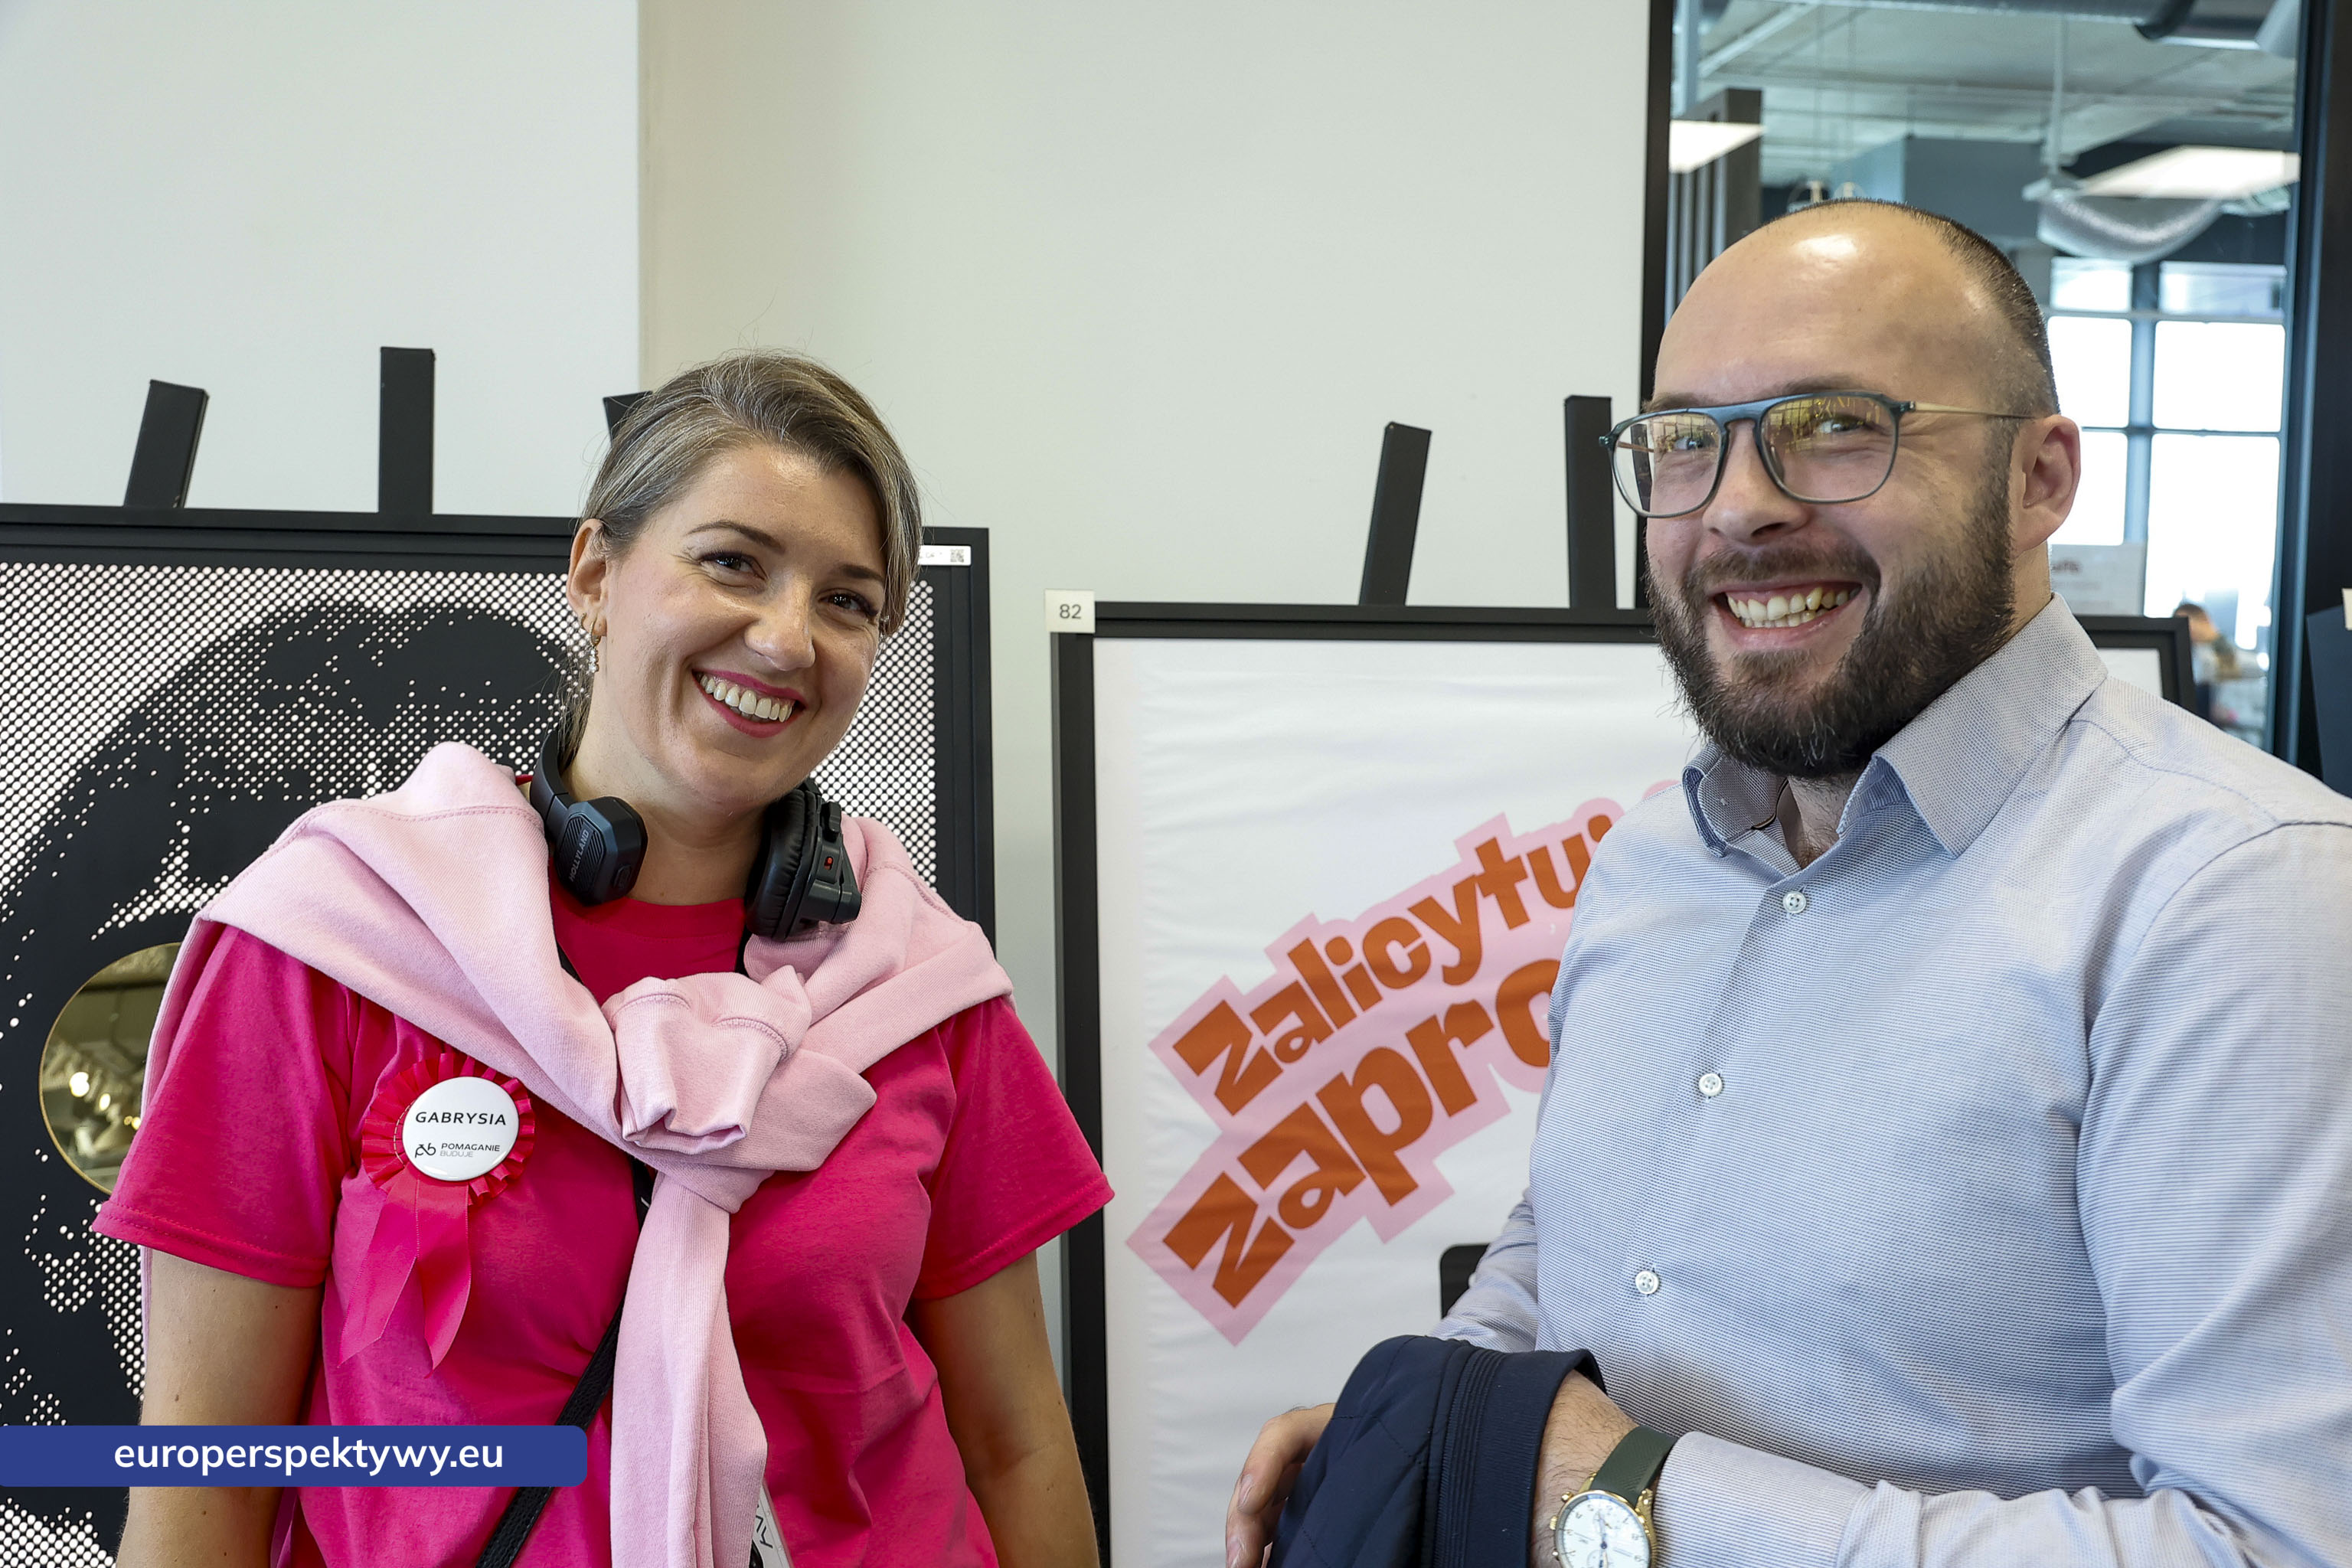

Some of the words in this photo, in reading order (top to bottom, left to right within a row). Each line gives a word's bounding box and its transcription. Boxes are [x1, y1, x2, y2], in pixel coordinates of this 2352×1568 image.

[1059, 604, 1082, 619] 82
[568, 829, 590, 882] HOLLYLAND
[1172, 814, 1613, 1116] Zalicytu
[415, 1112, 506, 1125] GABRYSIA
[441, 1143, 500, 1152] POMAGANIE
